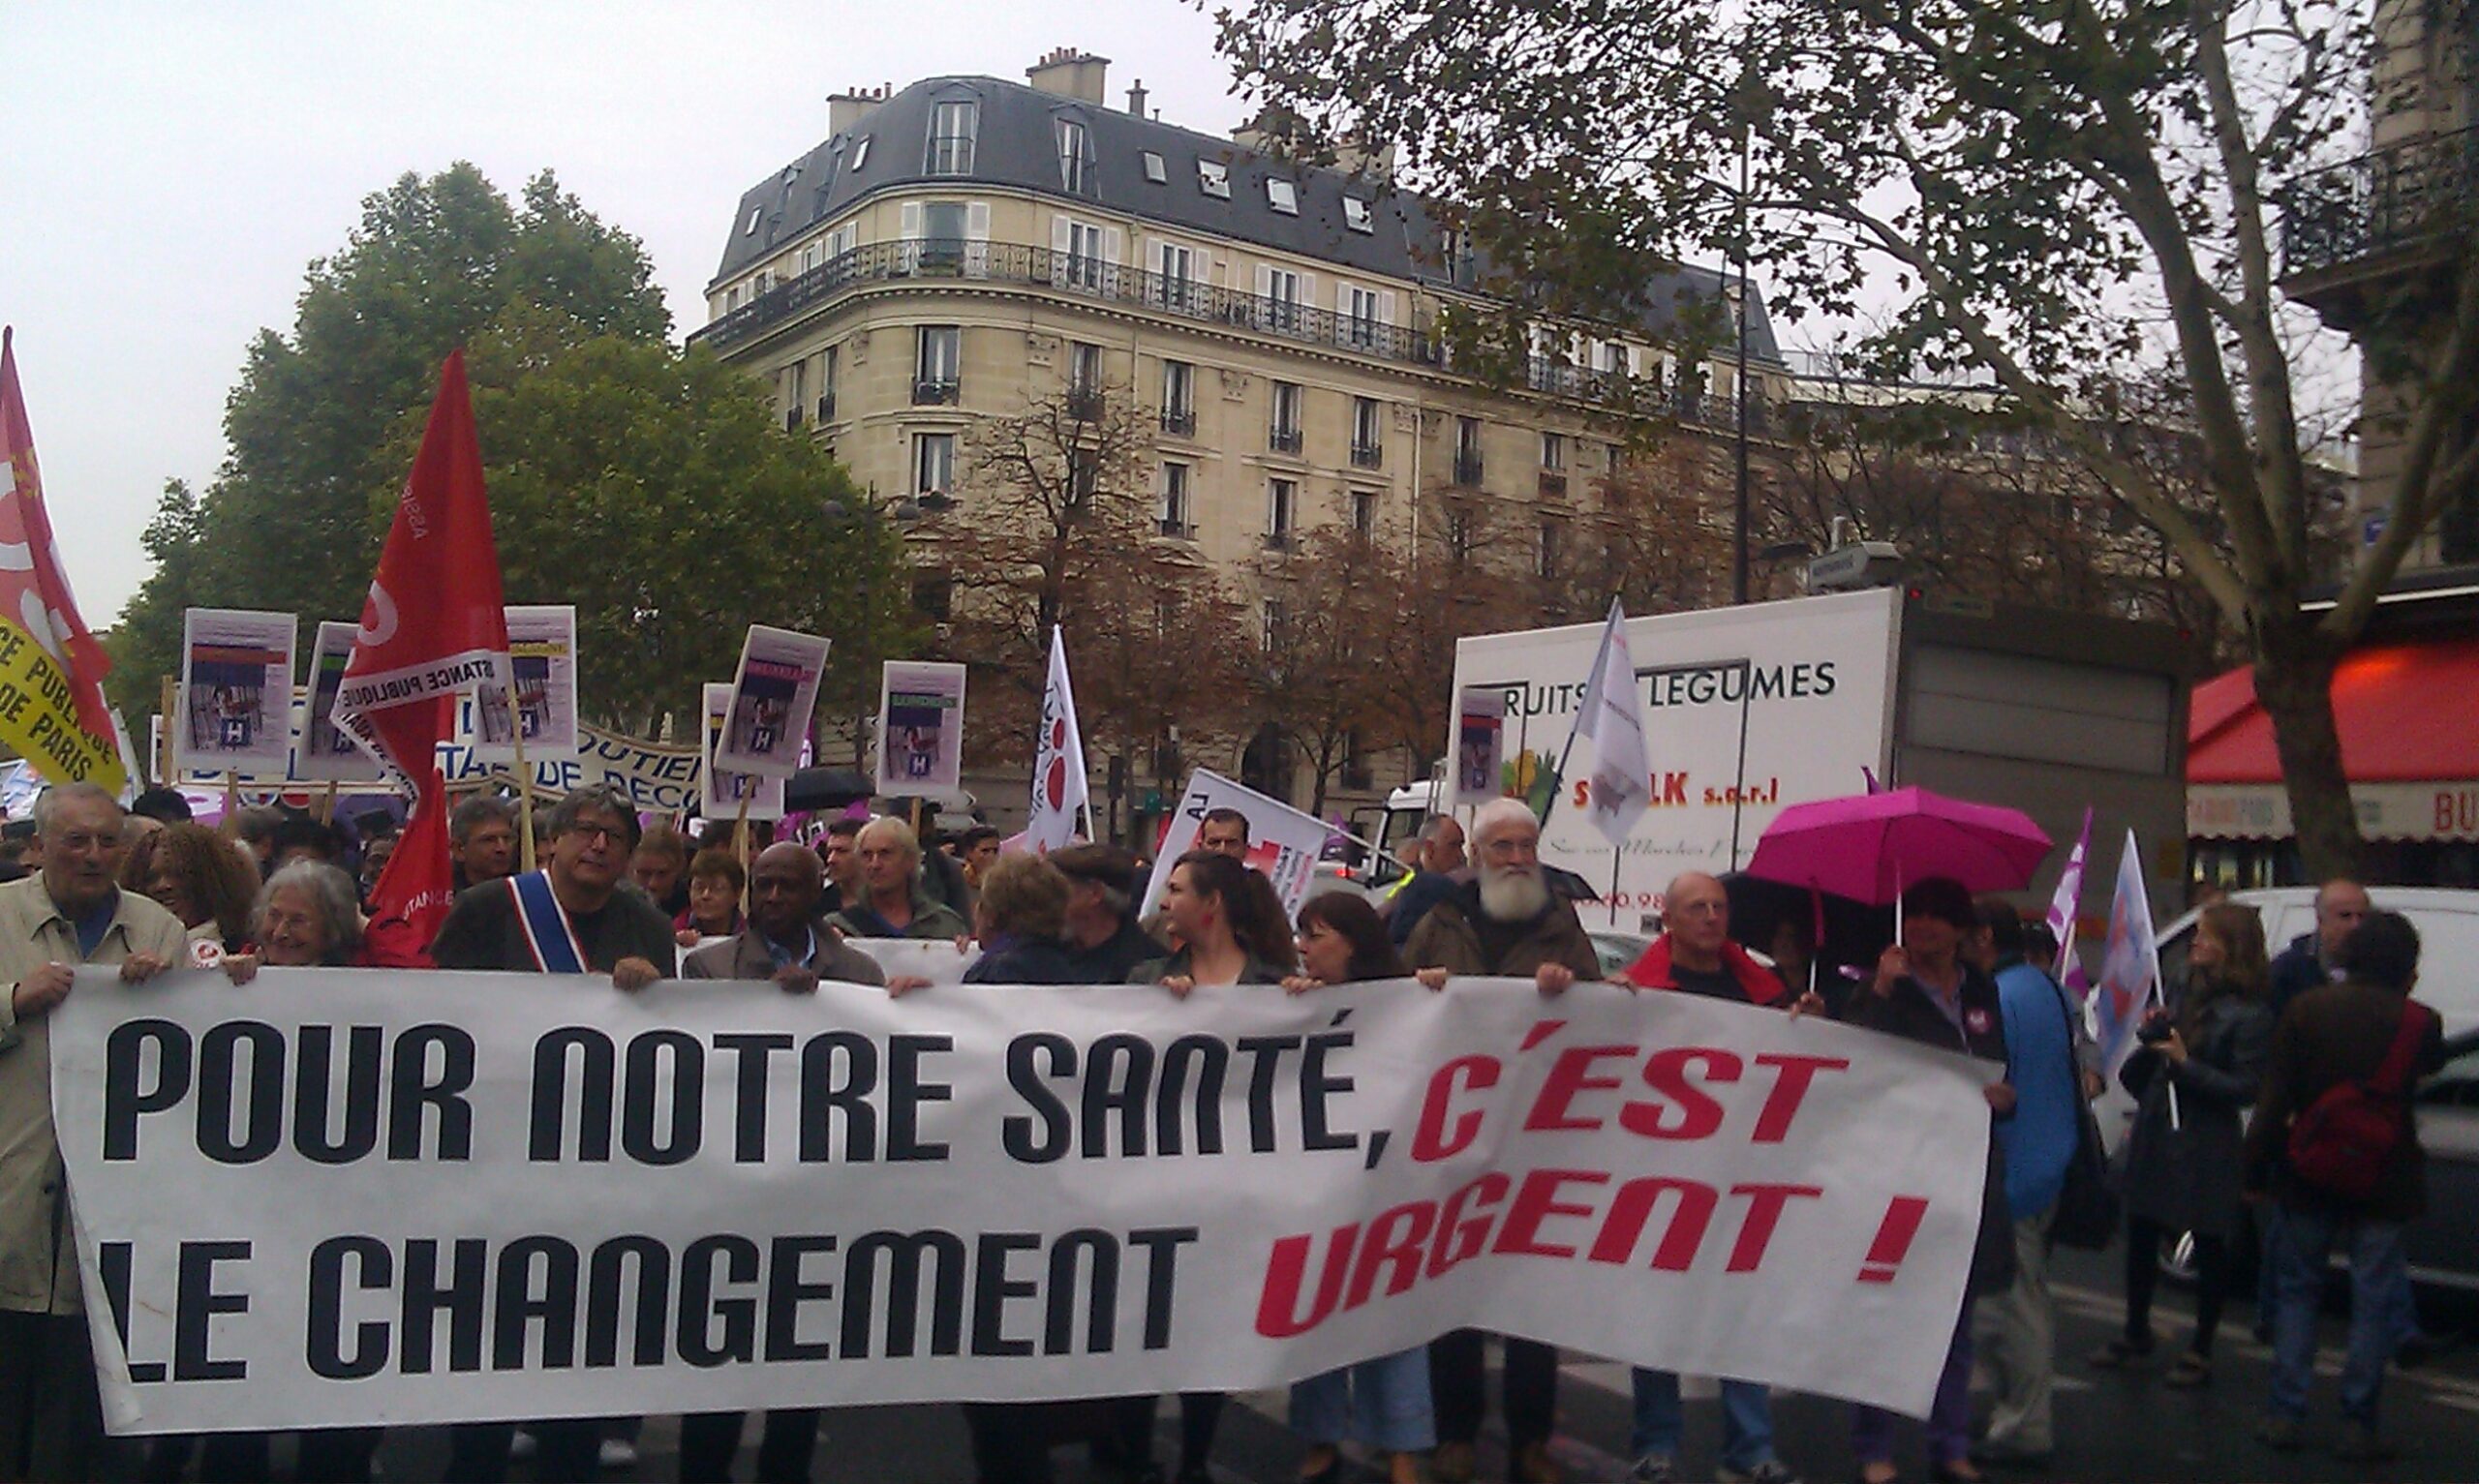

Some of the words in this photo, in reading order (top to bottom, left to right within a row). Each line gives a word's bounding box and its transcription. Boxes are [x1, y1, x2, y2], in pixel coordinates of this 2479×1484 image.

[1650, 662, 1836, 708] LEGUMES
[27, 712, 92, 783] PARIS
[103, 1017, 476, 1166] POUR
[528, 1025, 954, 1167] NOTRE
[1001, 1008, 1391, 1169] SANTÉ,
[1411, 1019, 1850, 1163] C'EST
[100, 1240, 253, 1382] LE
[305, 1227, 1200, 1380] CHANGEMENT
[1254, 1167, 1823, 1339] URGENT
